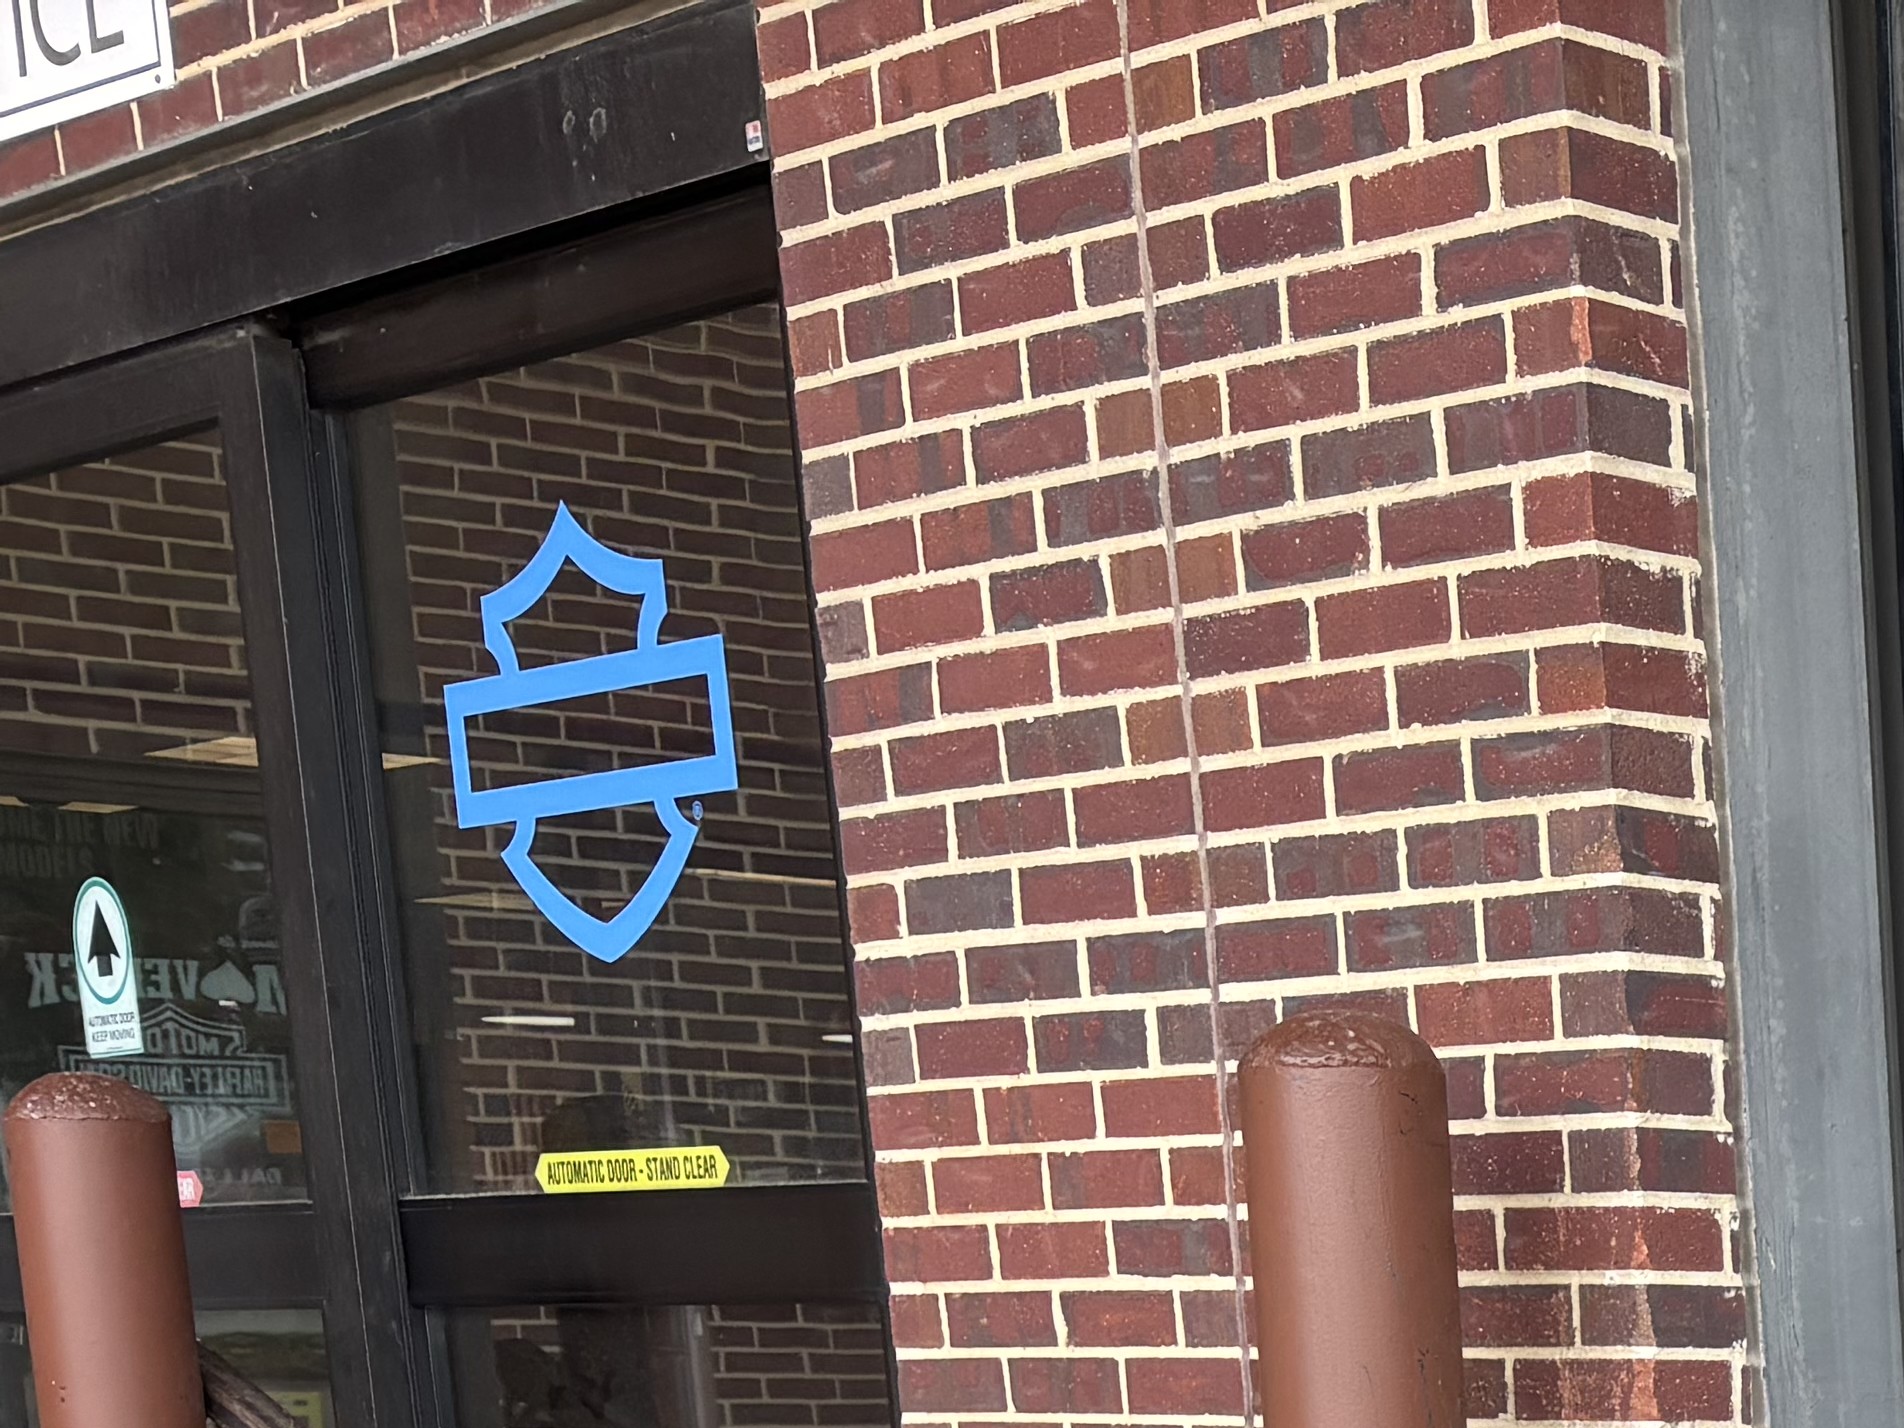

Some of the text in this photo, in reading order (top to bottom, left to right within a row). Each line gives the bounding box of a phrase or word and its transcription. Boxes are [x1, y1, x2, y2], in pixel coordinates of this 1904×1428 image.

[547, 1159, 605, 1186] AUTOMATIC
[606, 1158, 638, 1183] DOOR
[645, 1155, 682, 1181] STAND
[683, 1154, 719, 1179] CLEAR
